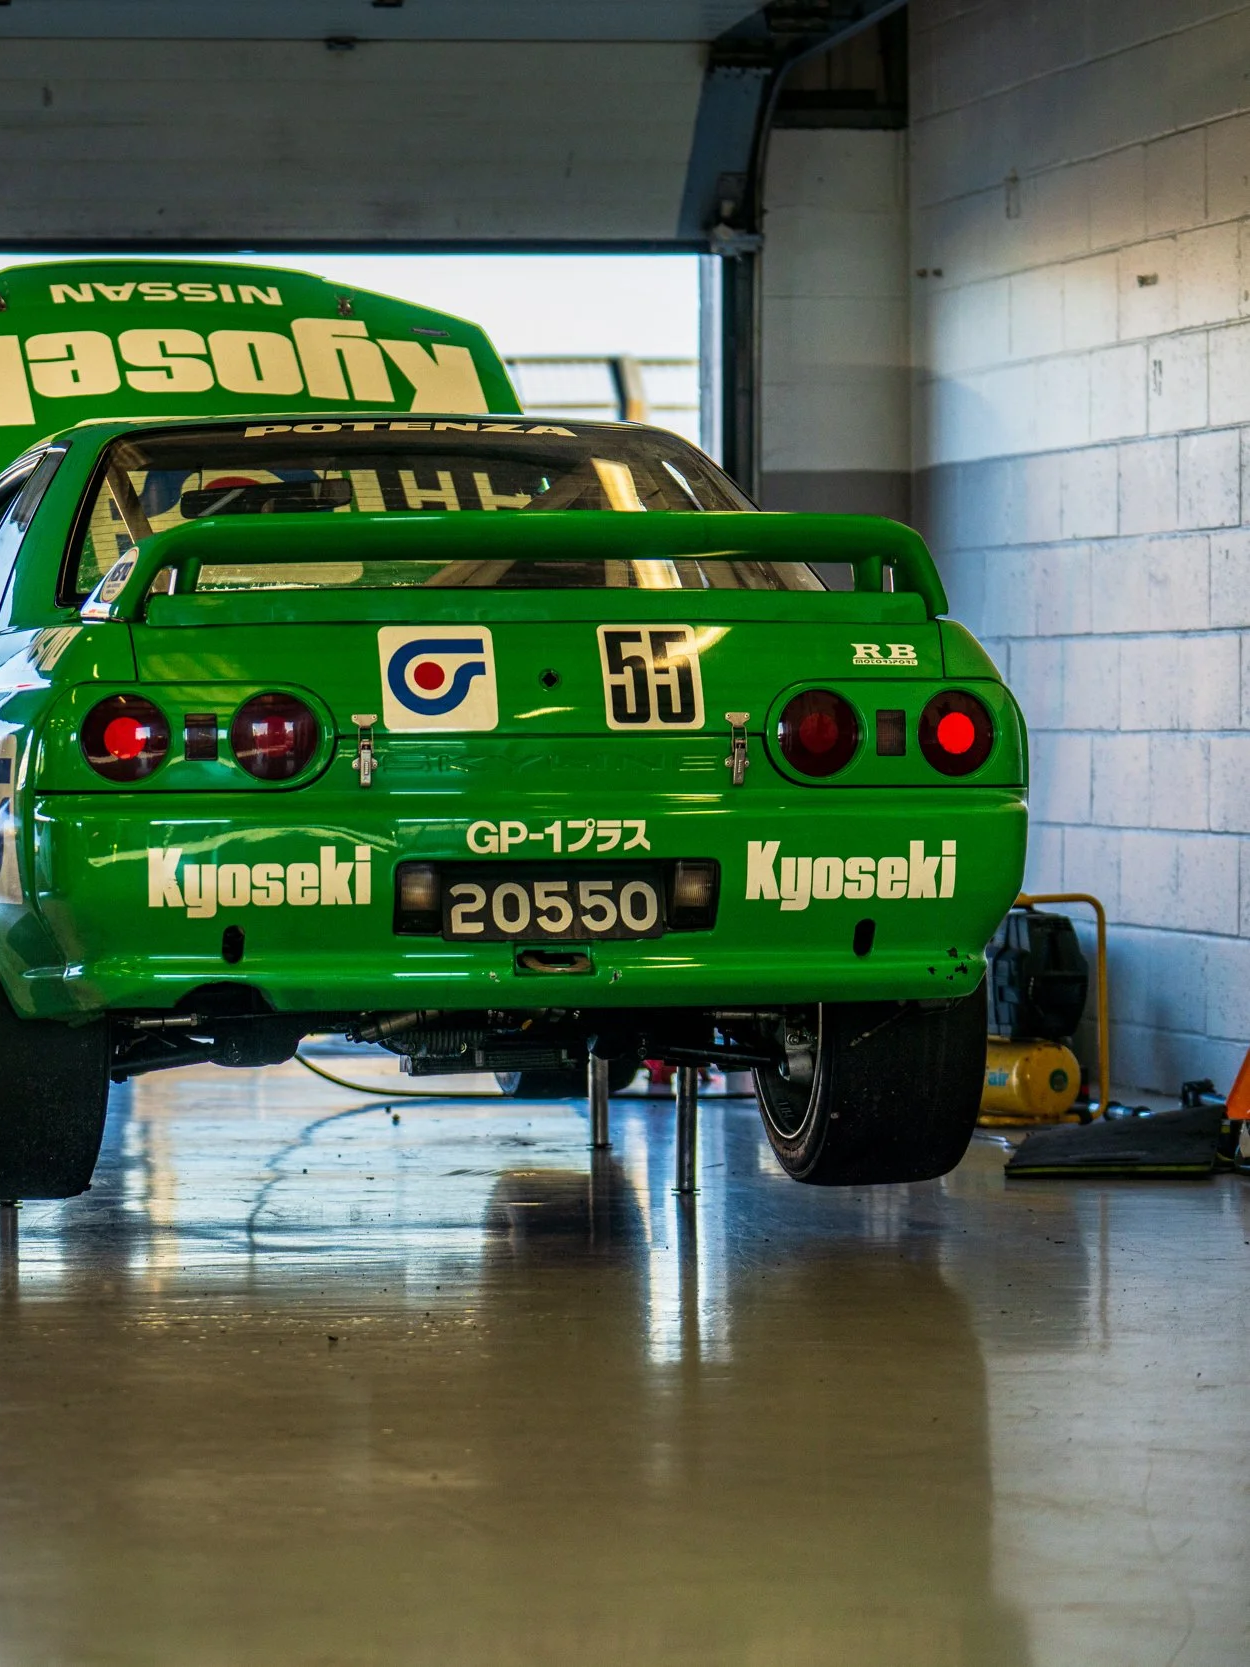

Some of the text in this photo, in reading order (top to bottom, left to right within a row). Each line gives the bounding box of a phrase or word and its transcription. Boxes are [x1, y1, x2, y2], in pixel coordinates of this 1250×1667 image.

[51, 282, 284, 306] NISSAN
[244, 422, 578, 438] POTENZA
[603, 630, 696, 723] 55
[850, 643, 917, 659] RB
[148, 845, 372, 919] Kyoseki
[745, 840, 957, 911] Kyoseki
[449, 881, 658, 934] 20550
